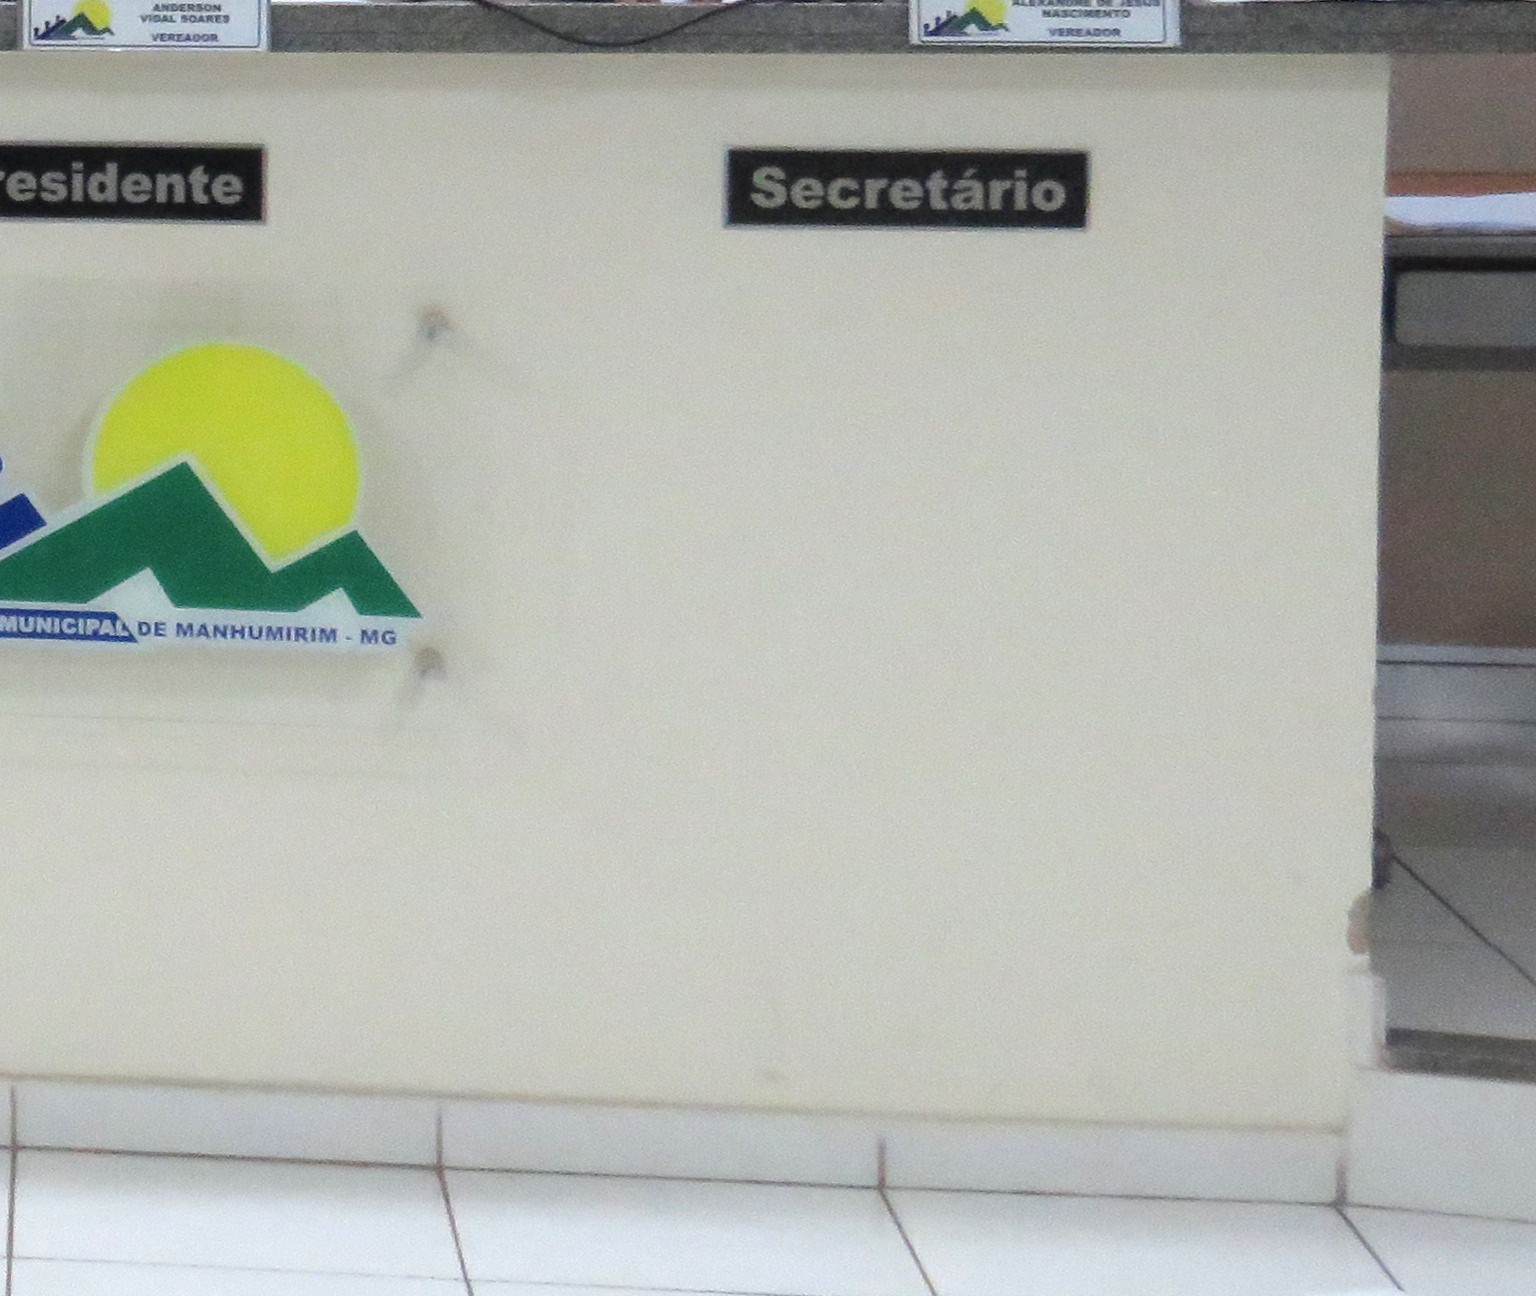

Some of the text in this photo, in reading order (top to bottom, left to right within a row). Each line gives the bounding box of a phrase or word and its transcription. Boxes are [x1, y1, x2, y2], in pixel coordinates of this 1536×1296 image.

[152, 3, 222, 13] ANDERSON
[139, 14, 230, 24] VIDAL SOARES
[1041, 9, 1131, 19] NASCIMENTO
[151, 33, 219, 43] VEREADOR
[1047, 28, 1121, 38] VEREADOR
[750, 165, 1066, 212] Secretário
[137, 621, 167, 637] DE
[176, 623, 338, 643] MANHUMIRIM
[360, 629, 397, 645] MG
